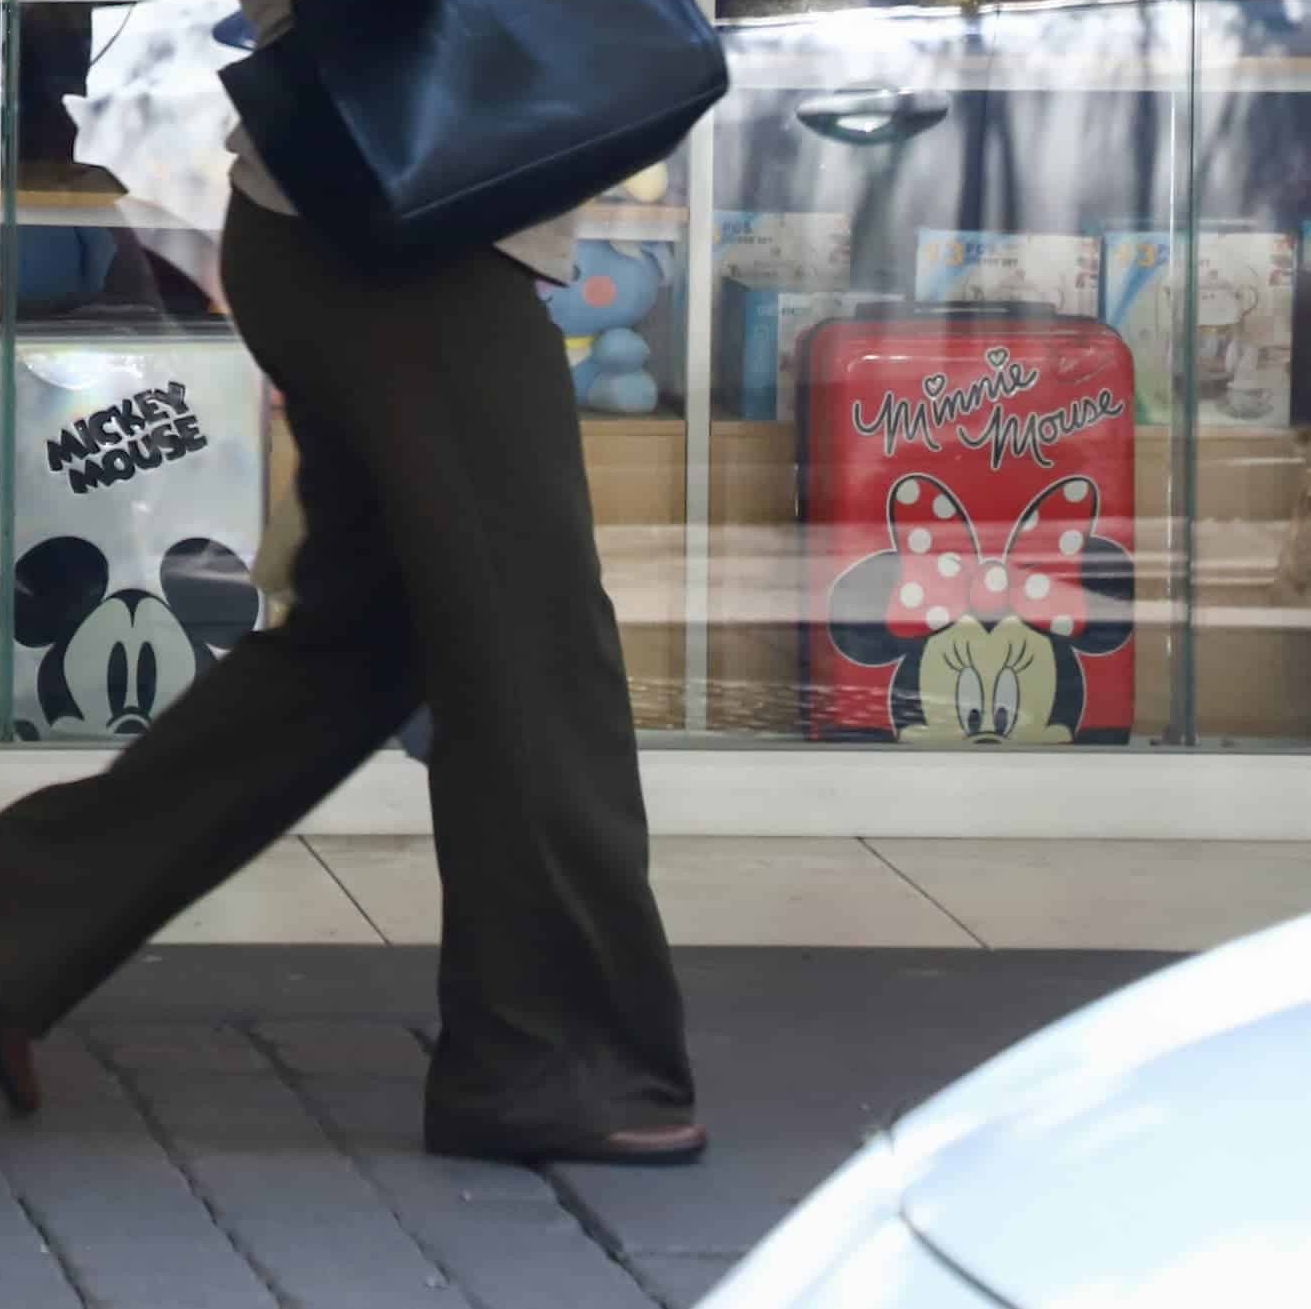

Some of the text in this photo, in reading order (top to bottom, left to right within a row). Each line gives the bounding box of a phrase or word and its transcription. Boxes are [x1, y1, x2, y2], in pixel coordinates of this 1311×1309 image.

[46, 381, 188, 472] MICKEY
[853, 347, 1039, 456] Minnie
[958, 388, 1125, 471] Mouse
[68, 416, 208, 495] MOUSE
